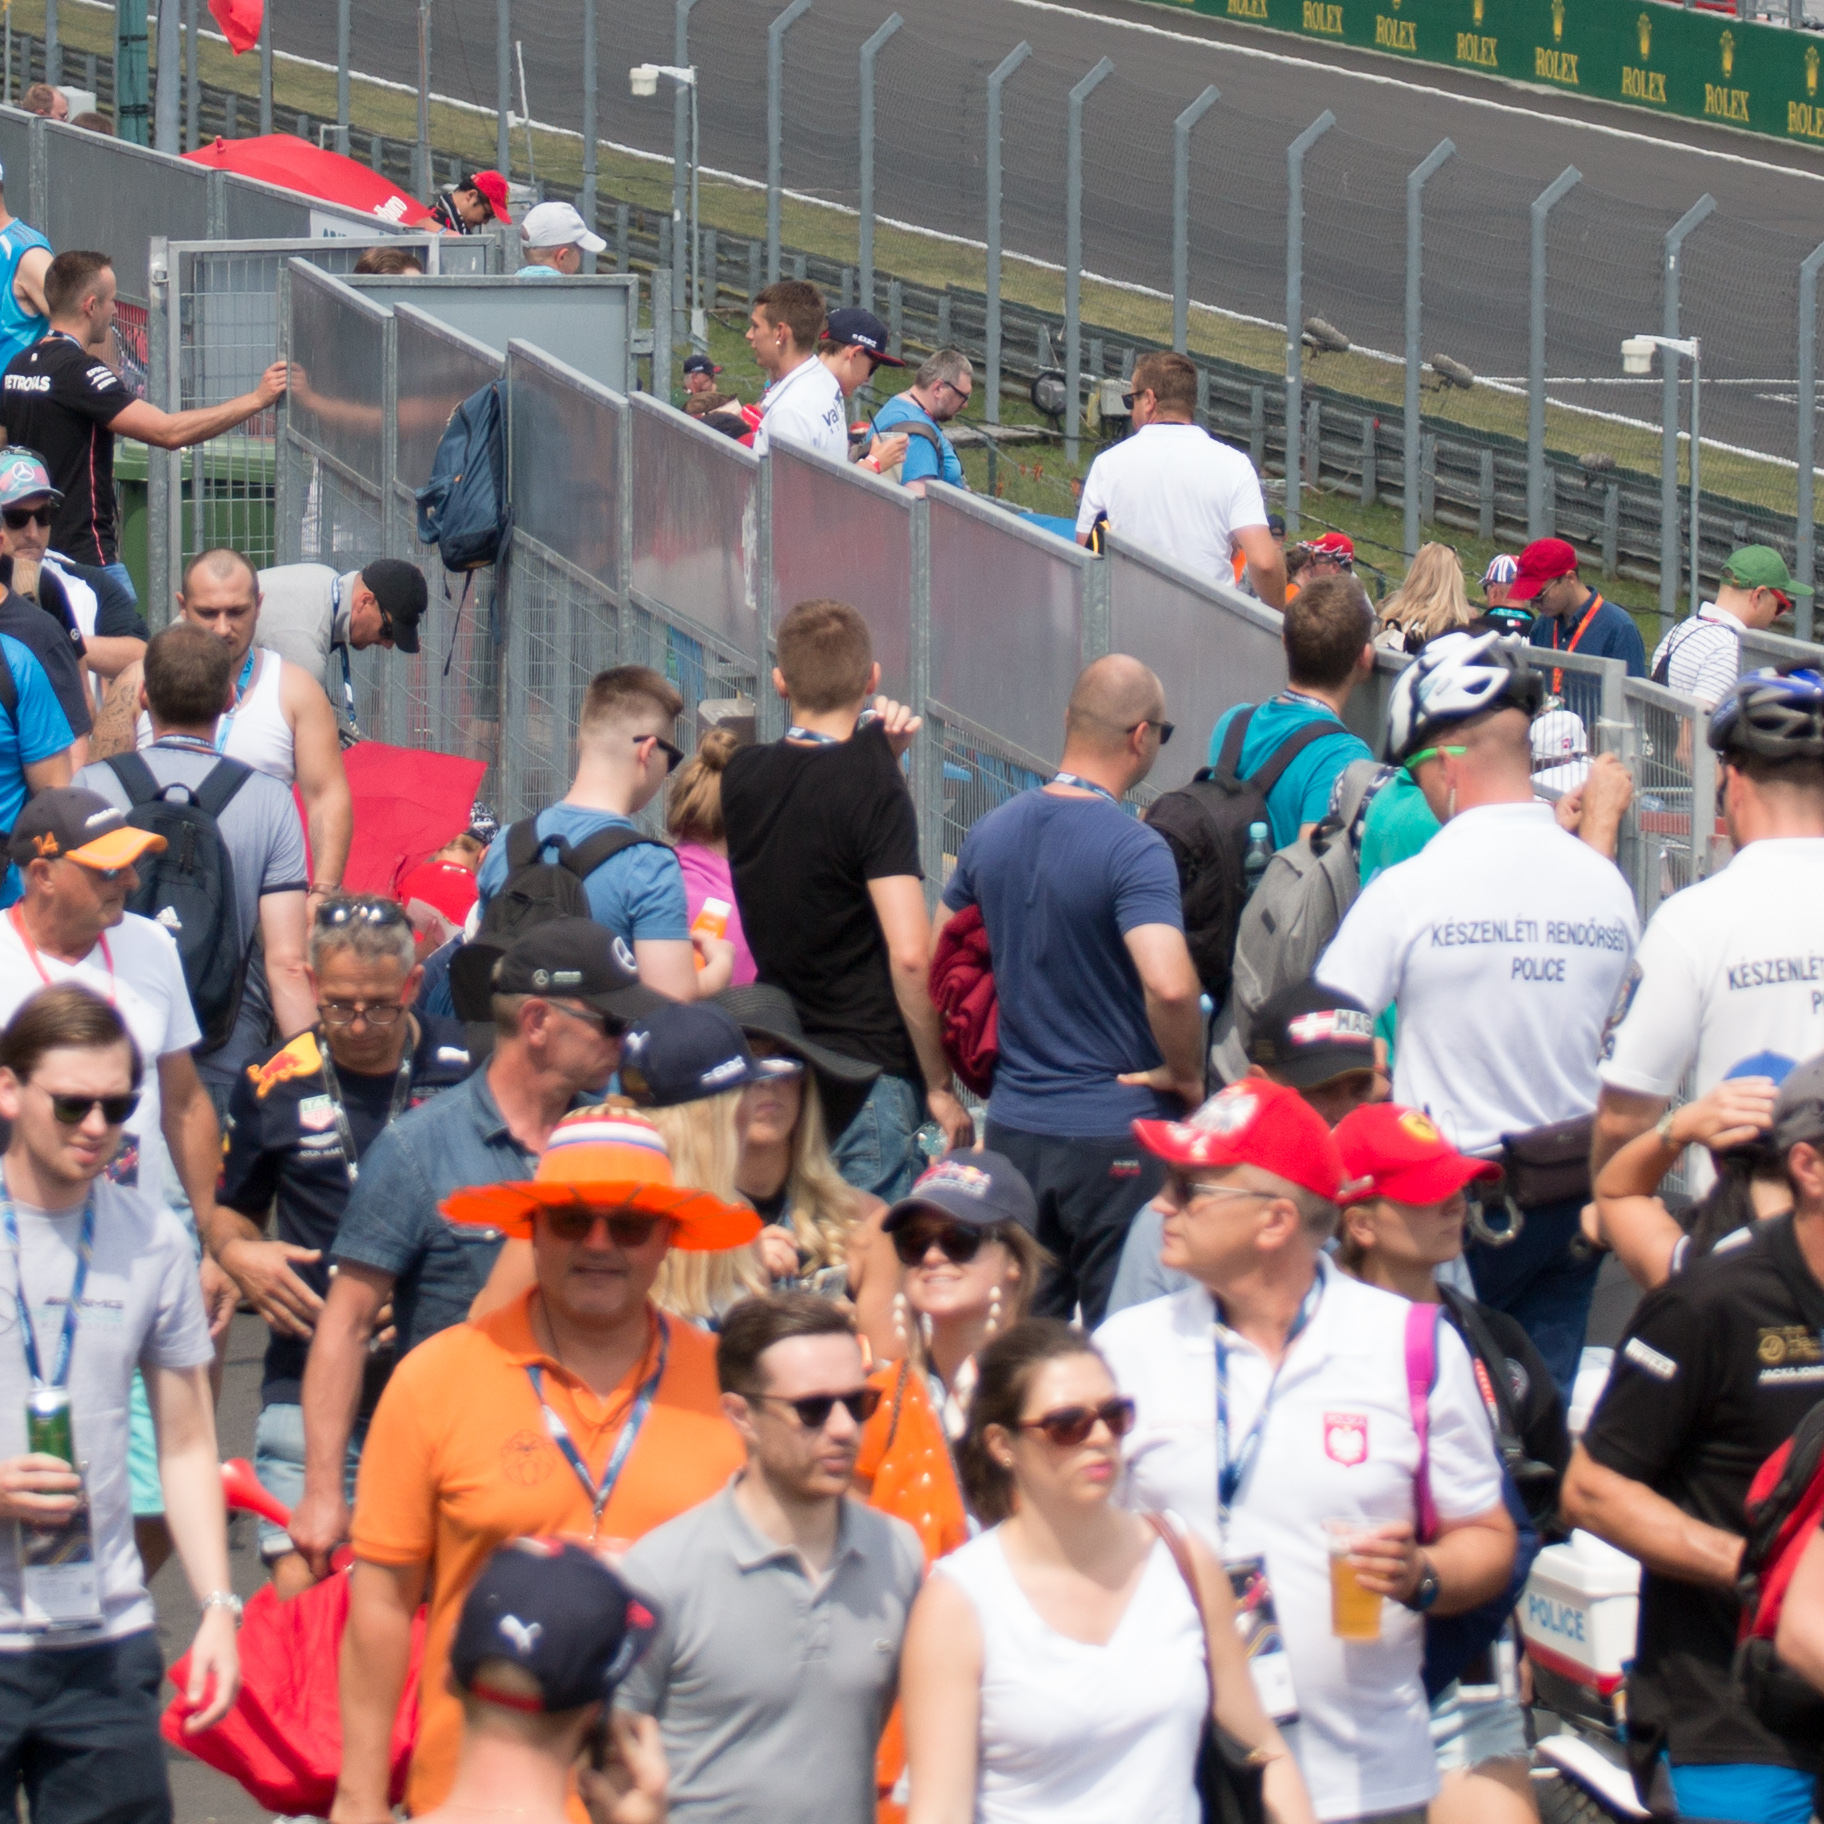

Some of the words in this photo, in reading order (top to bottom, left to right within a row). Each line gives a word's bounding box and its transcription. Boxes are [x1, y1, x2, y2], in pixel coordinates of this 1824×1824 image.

[1302, 0, 1343, 34] ROLEX
[1375, 14, 1417, 51] ROLEX
[1456, 32, 1498, 67] ROLEX
[1535, 46, 1579, 85] ROLEX
[1621, 66, 1667, 103] ROLEX
[1704, 83, 1750, 123] ROLEX
[32, 831, 59, 857] 14
[1431, 919, 1539, 948] KÉSZENLÉTI
[1547, 915, 1625, 953] RENDŐRSÉG
[1511, 957, 1566, 983] POLICE
[1528, 1592, 1587, 1644] POLICE
